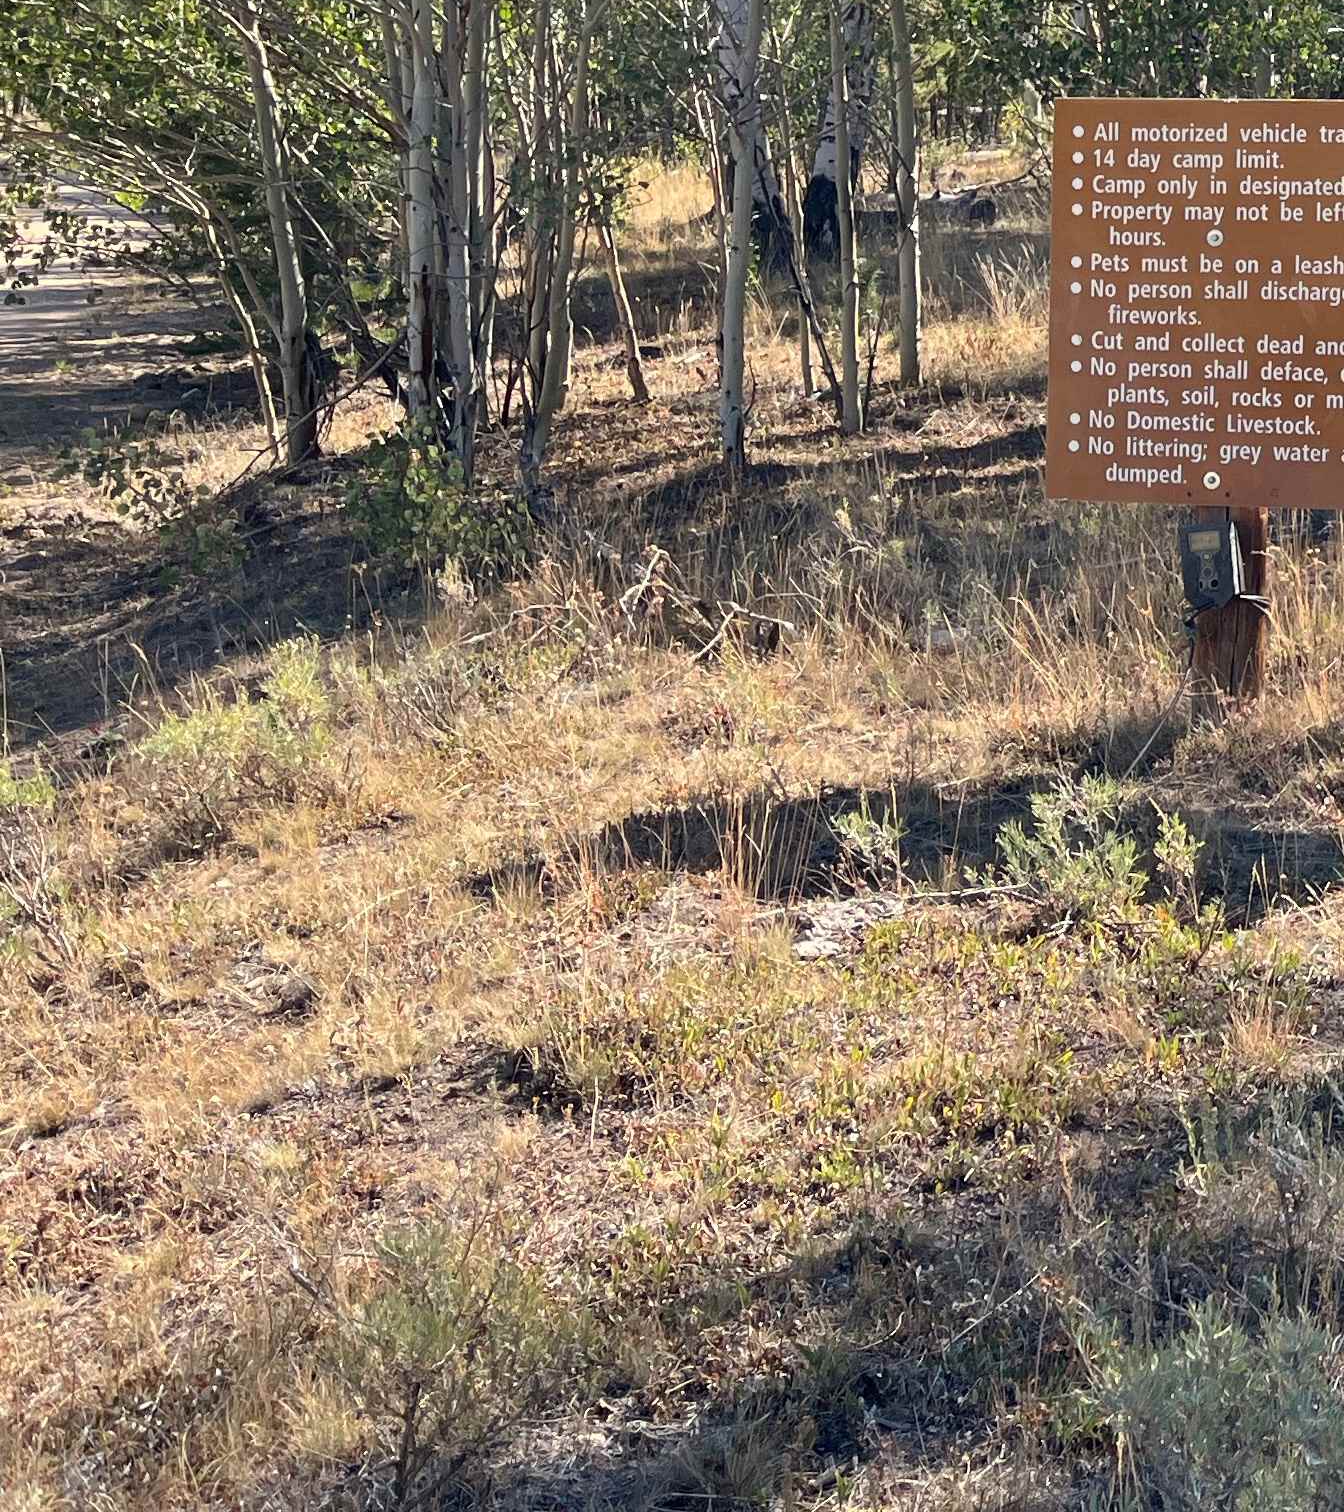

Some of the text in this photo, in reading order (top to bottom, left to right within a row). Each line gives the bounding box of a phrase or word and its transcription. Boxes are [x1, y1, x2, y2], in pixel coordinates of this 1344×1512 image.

[1093, 121, 1119, 142] All
[1131, 121, 1228, 143] motorized
[1239, 122, 1307, 143] vehicle
[1093, 147, 1285, 174] 14 day camp limit.
[1092, 174, 1146, 200] Camp
[1157, 174, 1199, 200] only
[1210, 174, 1227, 195] in
[1091, 200, 1173, 225] Property
[1184, 206, 1225, 226] may
[1236, 203, 1269, 222] not
[1280, 201, 1304, 222] be
[1109, 225, 1166, 247] hours.
[1090, 252, 1130, 273] Pets
[1141, 255, 1189, 273] must
[1199, 252, 1223, 273] be
[1235, 259, 1259, 274] on
[1270, 259, 1282, 274] a
[1295, 254, 1344, 275] leash
[1090, 278, 1117, 298] No
[1128, 283, 1192, 304] person
[1204, 279, 1248, 300] shall
[1107, 303, 1202, 326] fireworks.
[1091, 330, 1124, 351] Cut
[1134, 331, 1170, 352] and
[1181, 332, 1246, 354] collect
[1256, 333, 1304, 355] dead
[1090, 356, 1117, 377] No
[1127, 362, 1192, 382] person
[1204, 359, 1248, 380] shall
[1260, 360, 1329, 385] deface,
[1107, 382, 1170, 408] plants,
[1181, 385, 1219, 409] soil,
[1231, 386, 1282, 408] rocks
[1294, 393, 1315, 409] or
[1088, 409, 1321, 436] No Domestic Livestock.
[1088, 435, 1114, 456] No
[1126, 436, 1208, 464] littering;
[1219, 444, 1262, 466] grey
[1272, 444, 1330, 463] water
[1105, 462, 1187, 488] dumped.
